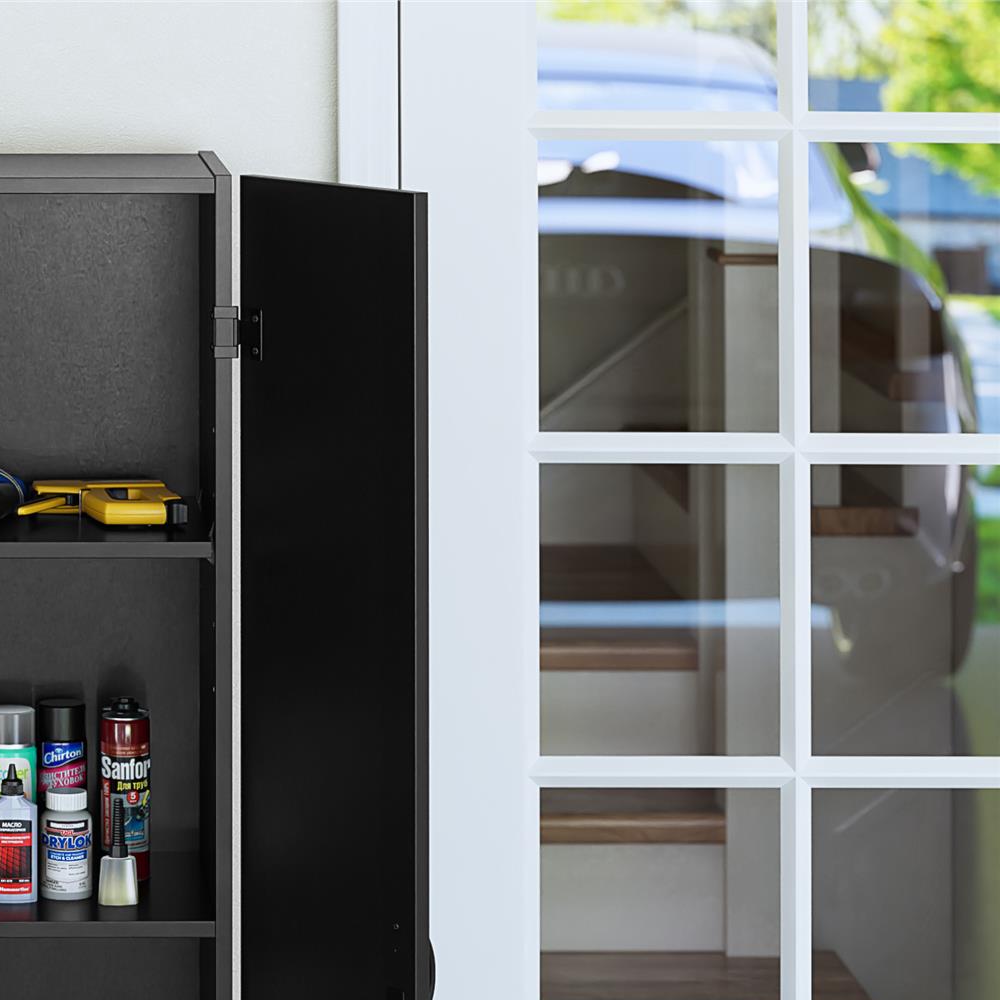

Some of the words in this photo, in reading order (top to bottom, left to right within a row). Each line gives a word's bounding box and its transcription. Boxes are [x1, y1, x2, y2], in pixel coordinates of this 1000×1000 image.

[44, 749, 82, 764] Chirton
[101, 756, 151, 780] Sanfor
[41, 832, 92, 849] DRYLOK
